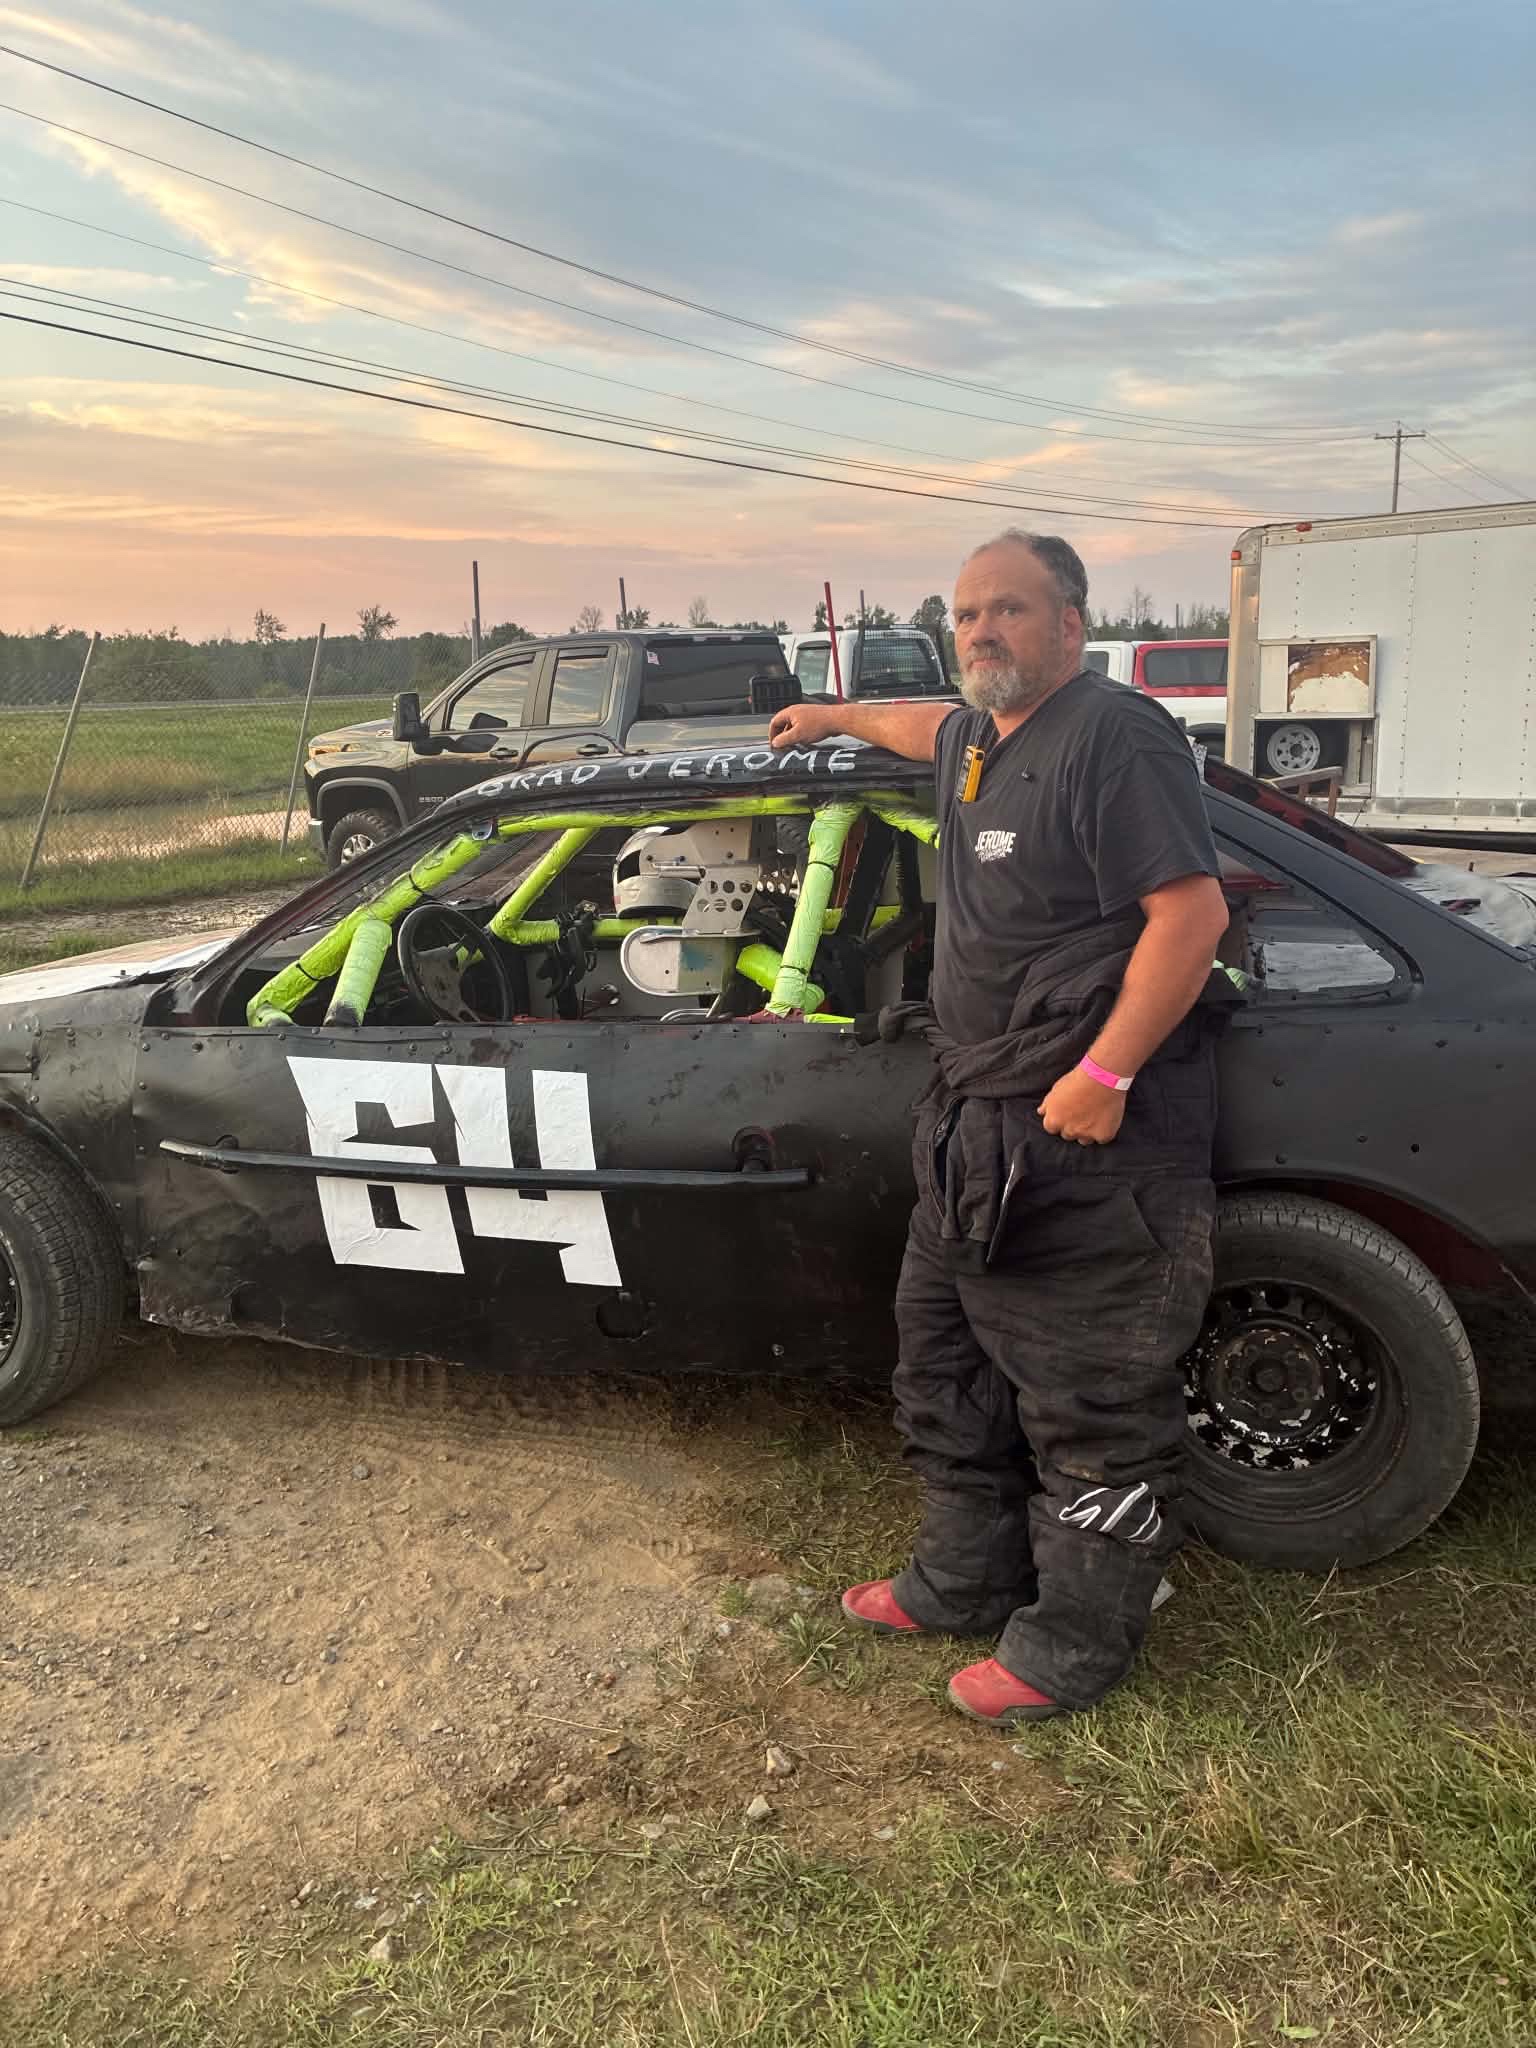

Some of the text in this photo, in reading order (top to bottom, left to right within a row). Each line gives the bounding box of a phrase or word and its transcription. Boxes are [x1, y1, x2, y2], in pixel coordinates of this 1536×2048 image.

[628, 750, 857, 780] JEROME
[975, 830, 1016, 853] JEROME
[286, 1056, 622, 1287] 64
